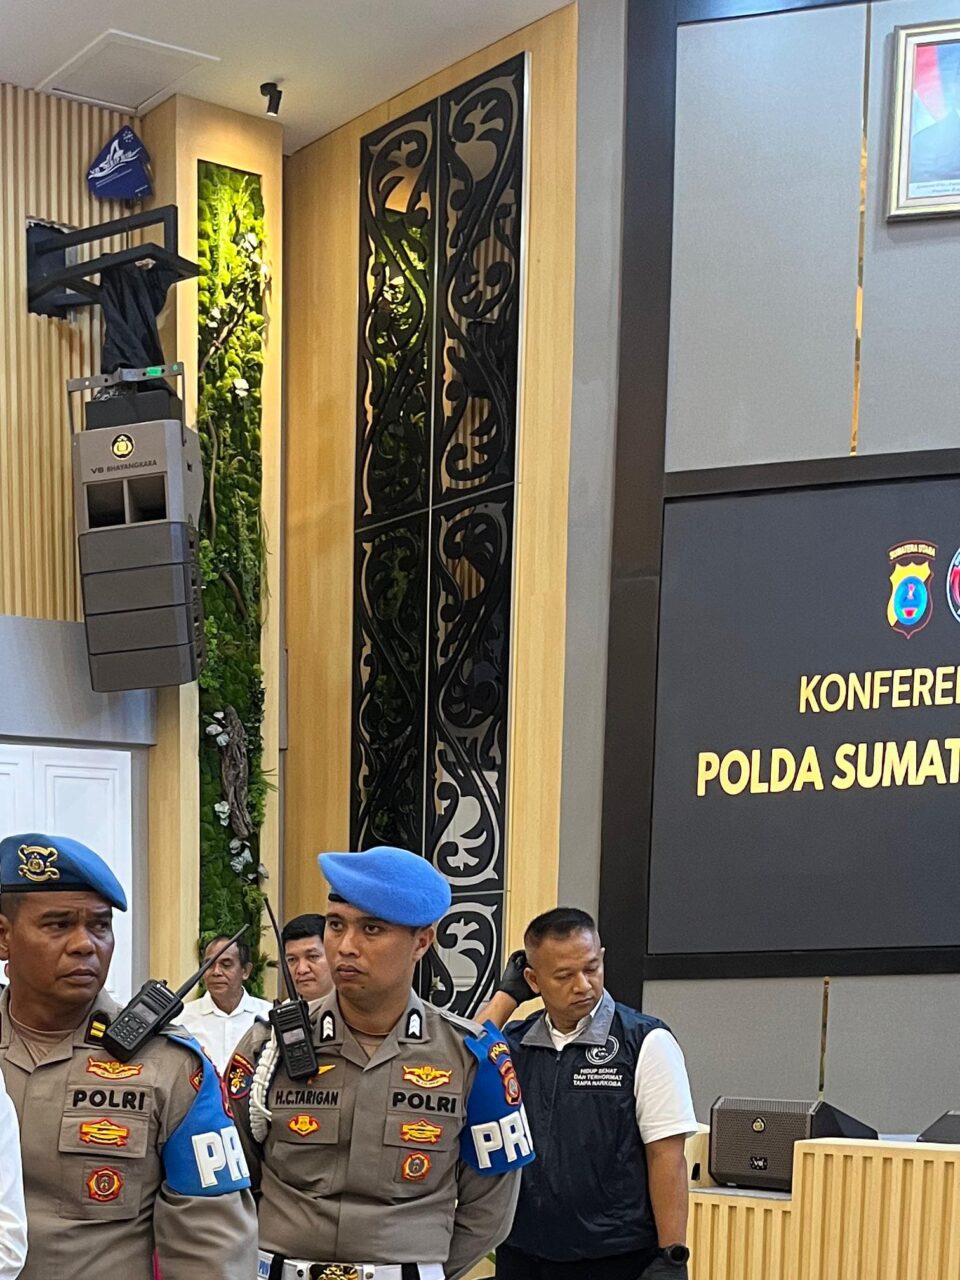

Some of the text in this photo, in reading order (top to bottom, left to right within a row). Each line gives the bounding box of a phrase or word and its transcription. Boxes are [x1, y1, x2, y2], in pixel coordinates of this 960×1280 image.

[799, 665, 960, 714] KONFERE
[696, 737, 960, 797] POLDA SUMAT
[73, 1089, 145, 1111] POLRI
[275, 1089, 339, 1106] H.C.TARIGAN
[392, 1091, 457, 1114] POLRI
